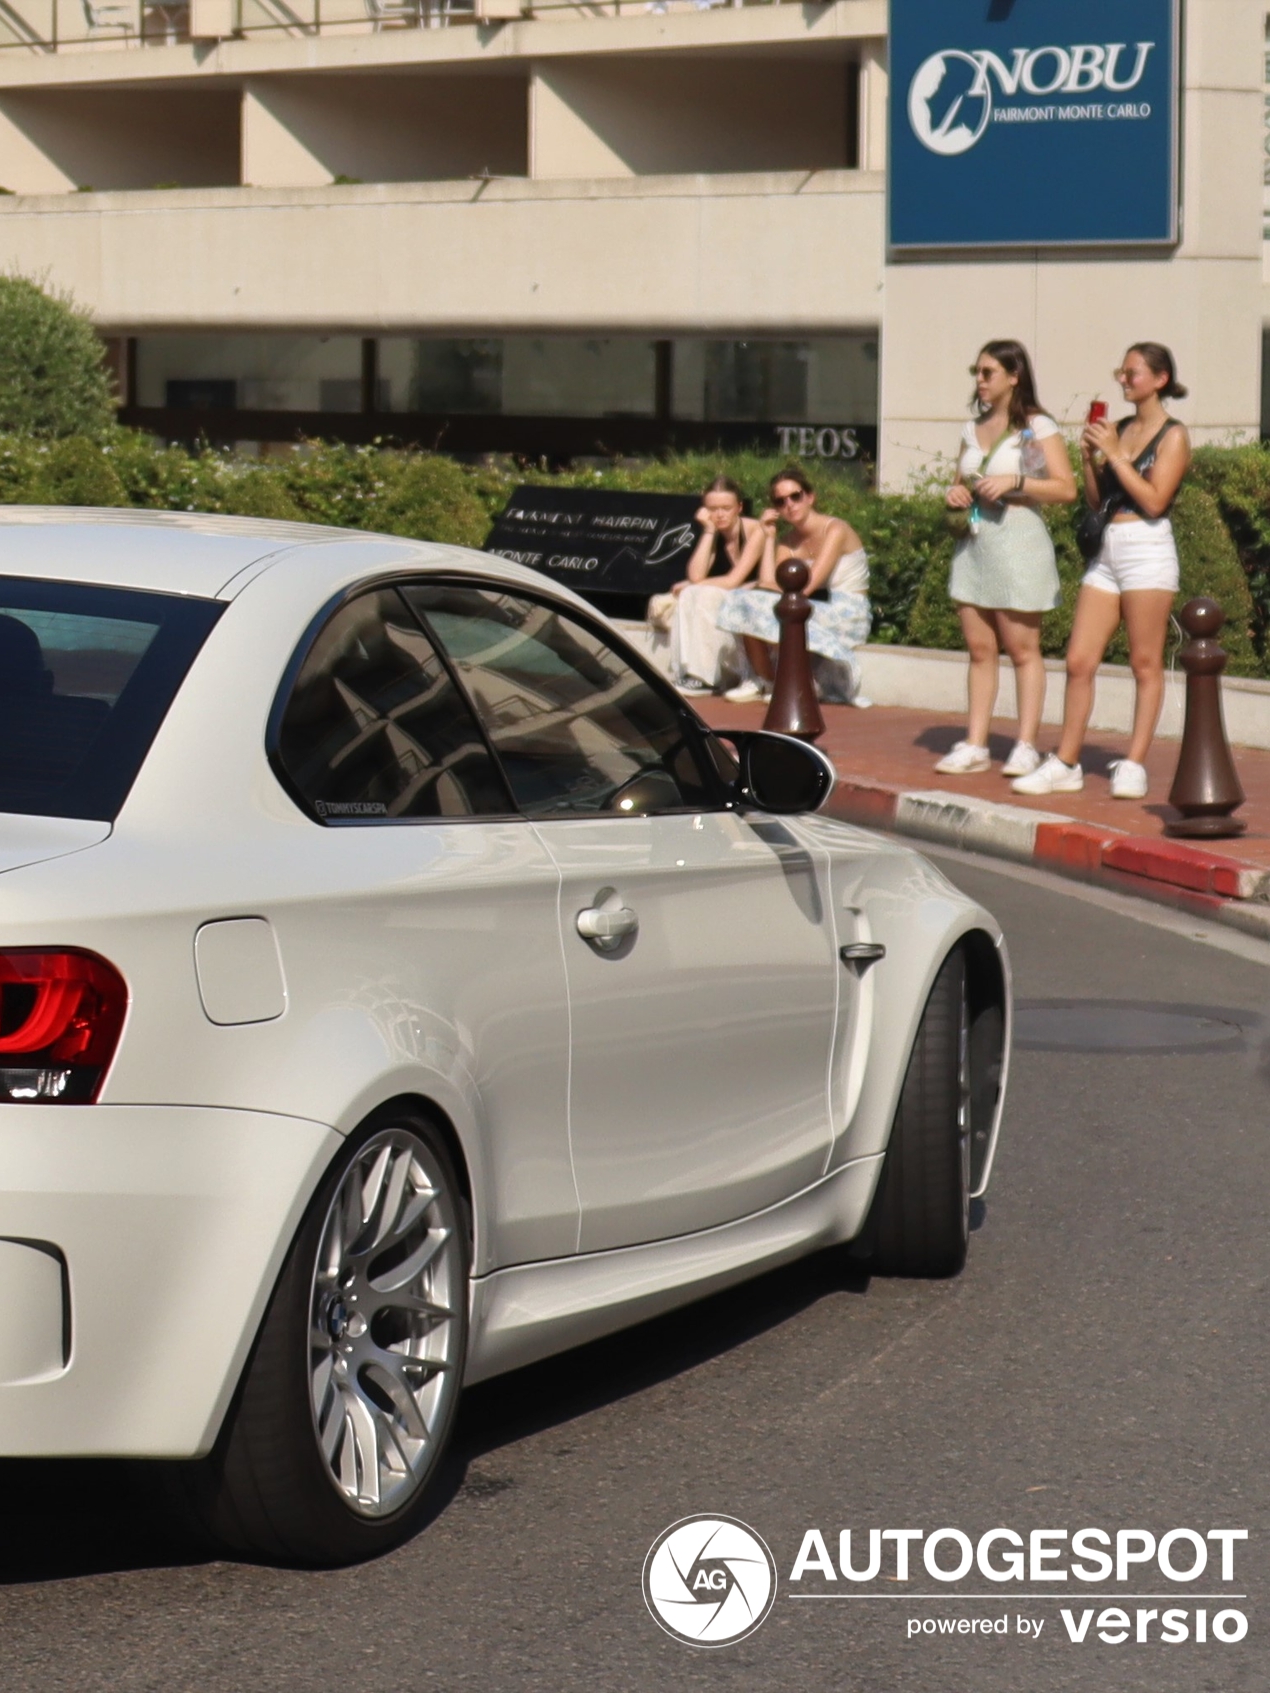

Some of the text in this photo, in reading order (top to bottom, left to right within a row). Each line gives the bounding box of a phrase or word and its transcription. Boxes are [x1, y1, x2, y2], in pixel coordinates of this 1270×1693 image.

[967, 42, 1155, 96] NOBU
[993, 102, 1151, 122] FAIRMONT MONTE CARLO
[776, 426, 857, 458] TEOS
[592, 515, 658, 530] HAIRPIN
